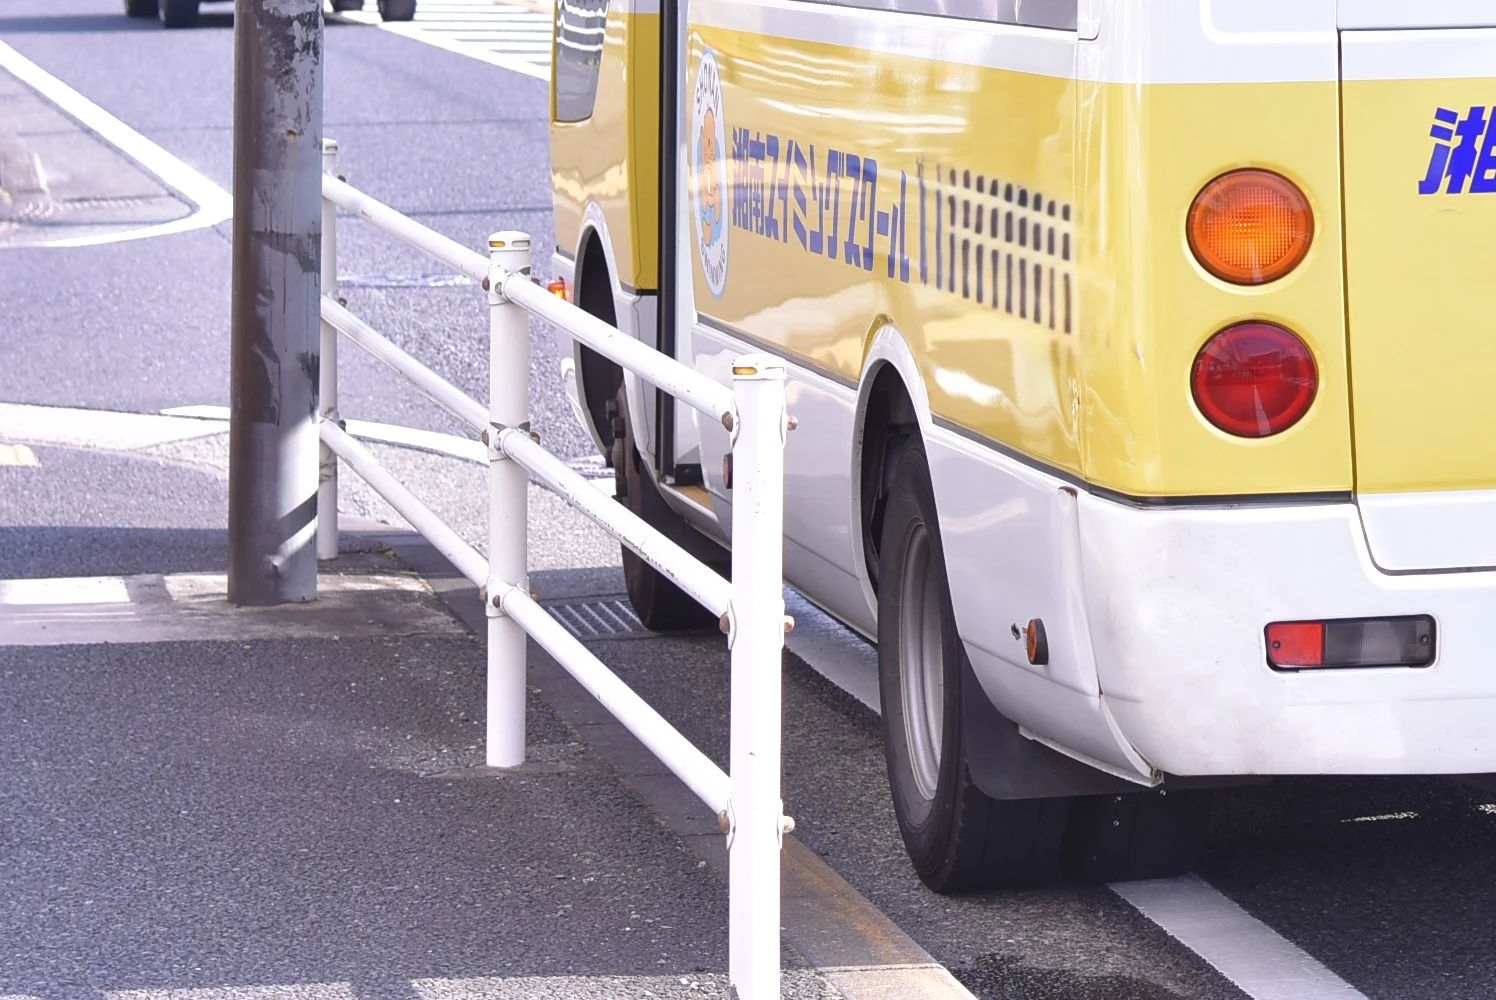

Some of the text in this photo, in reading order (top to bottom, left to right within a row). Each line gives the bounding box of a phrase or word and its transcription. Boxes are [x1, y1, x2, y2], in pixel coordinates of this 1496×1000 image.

[732, 127, 910, 284] 湘南スイミングスクール
